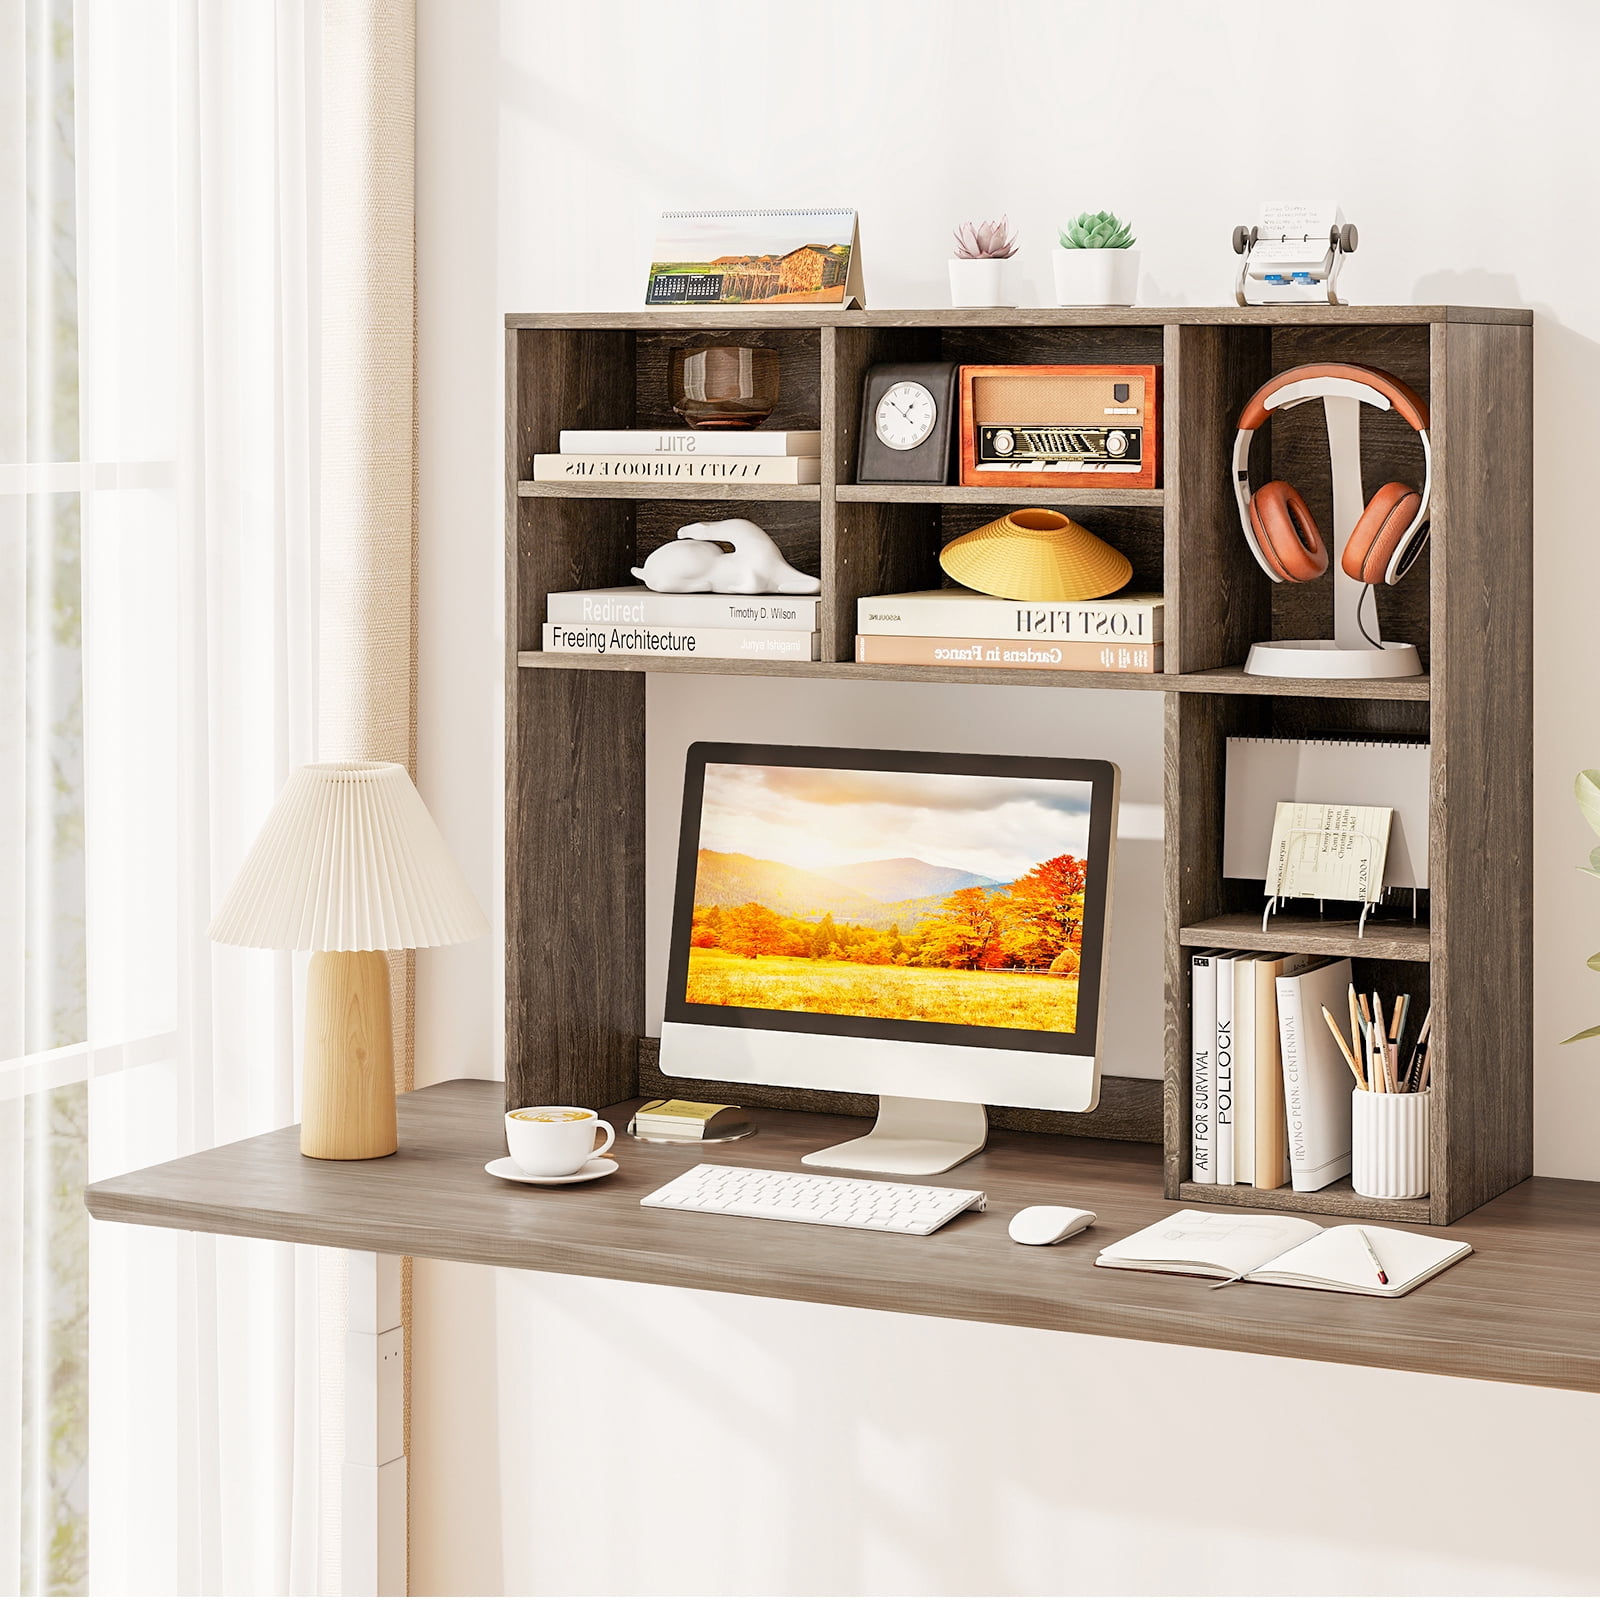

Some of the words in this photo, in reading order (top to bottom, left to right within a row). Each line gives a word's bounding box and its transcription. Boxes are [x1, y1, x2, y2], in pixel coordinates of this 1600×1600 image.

[583, 598, 646, 623] Redirect
[729, 606, 759, 621] Timothy
[760, 608, 769, 620] D.
[770, 608, 797, 620] Wilson
[553, 626, 606, 653] Freeing
[609, 628, 697, 652] Architecture
[1285, 1015, 1300, 1083] CENTENNIAL
[1195, 1050, 1209, 1110] SURVIVAL
[1217, 1020, 1232, 1125] POLLOCK
[1195, 1113, 1209, 1142] FOR
[1292, 1120, 1305, 1161] IRVING
[1195, 1144, 1209, 1171] ART
